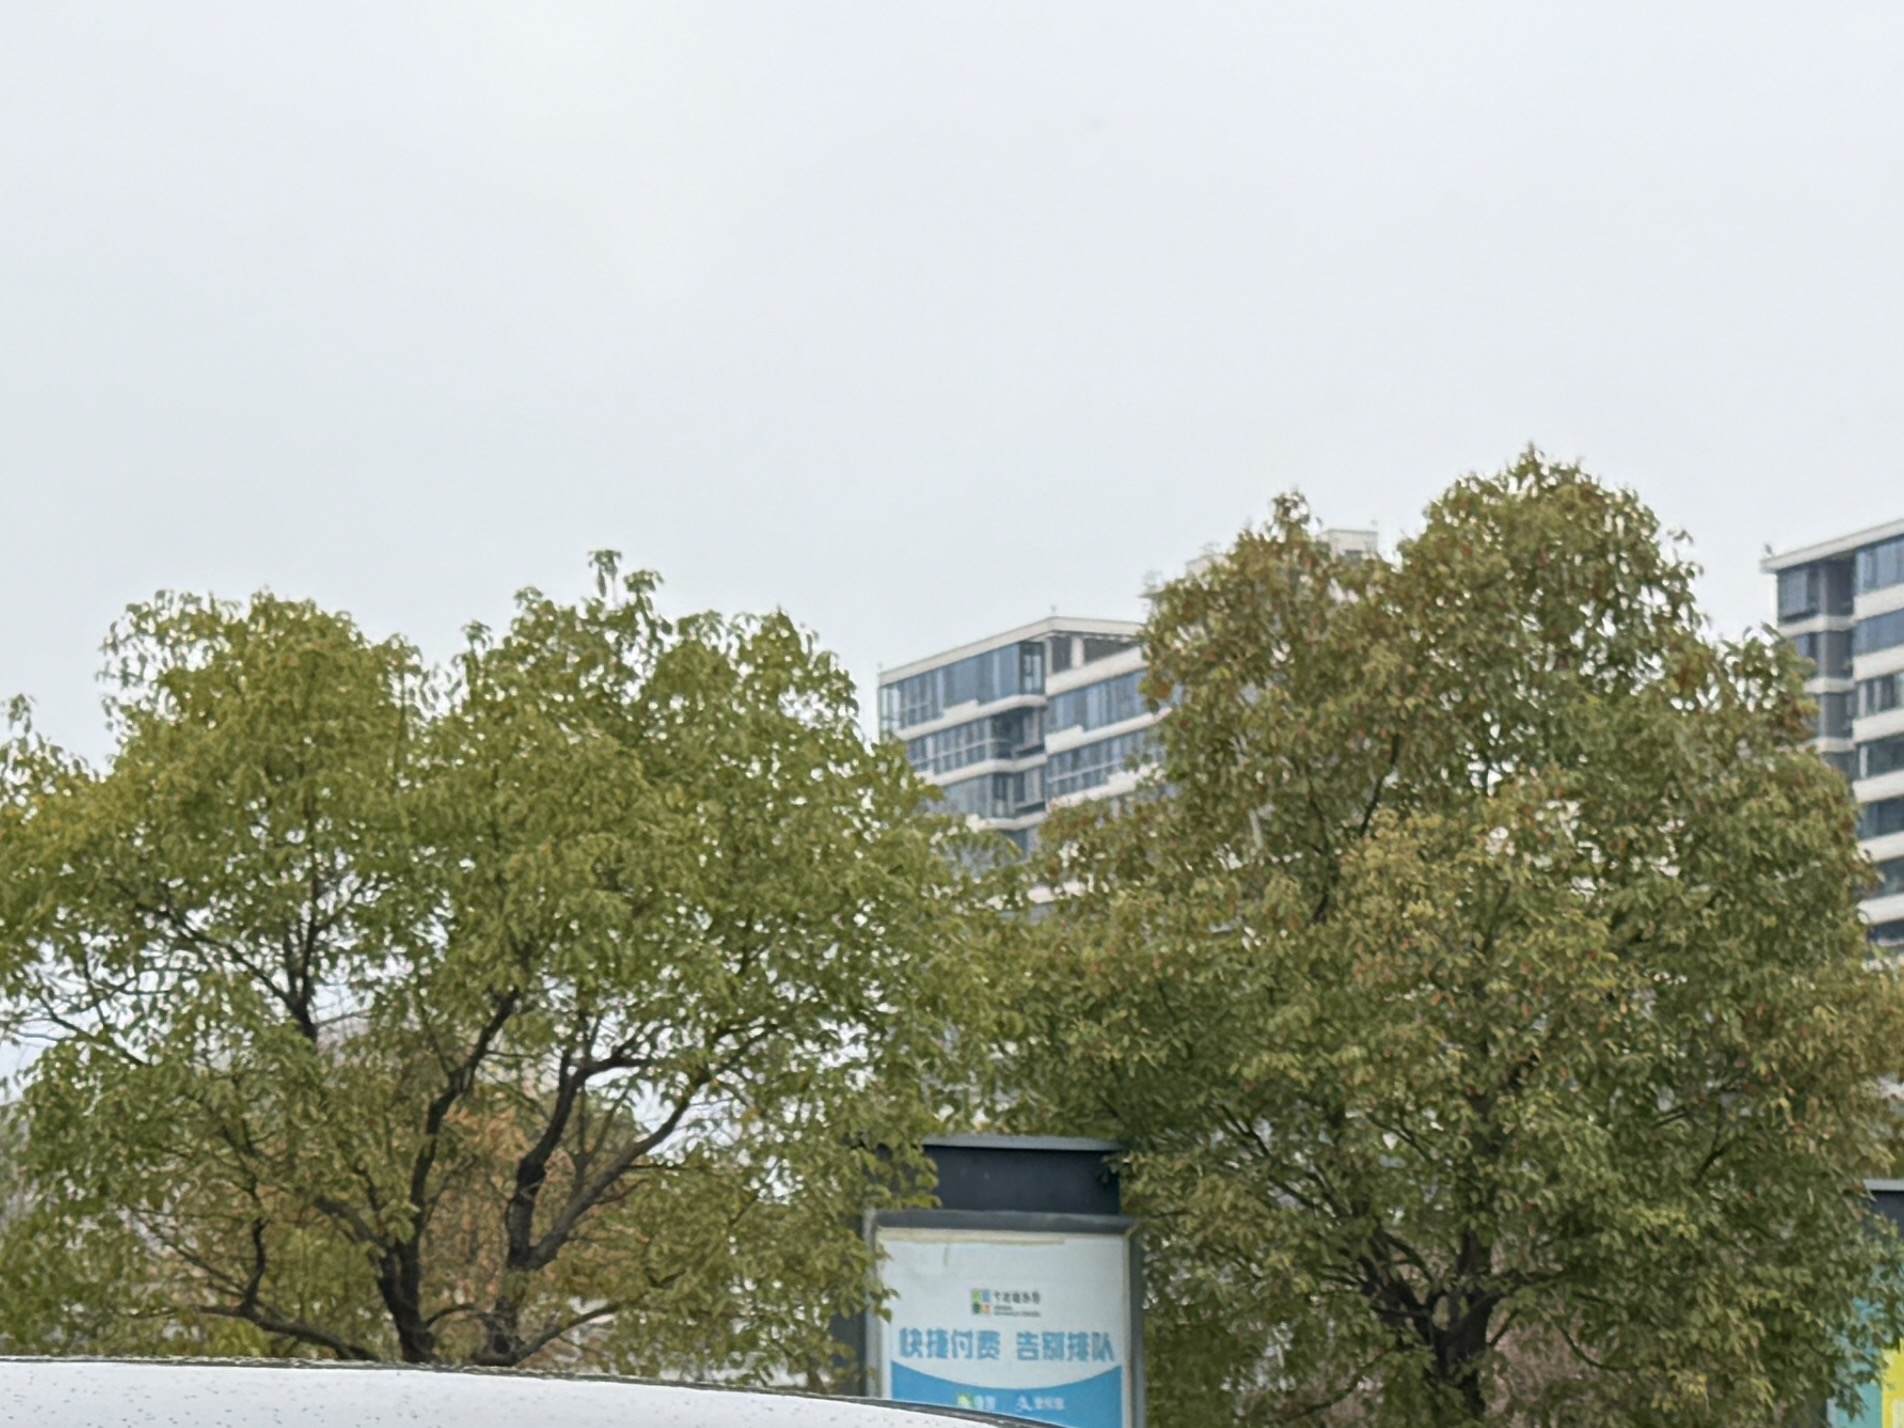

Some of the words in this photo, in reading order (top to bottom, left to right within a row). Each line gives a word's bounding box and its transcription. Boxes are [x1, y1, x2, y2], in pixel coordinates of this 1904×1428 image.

[899, 1329, 1001, 1360] 快捷付费
[1017, 1332, 1114, 1362] 告别排队
